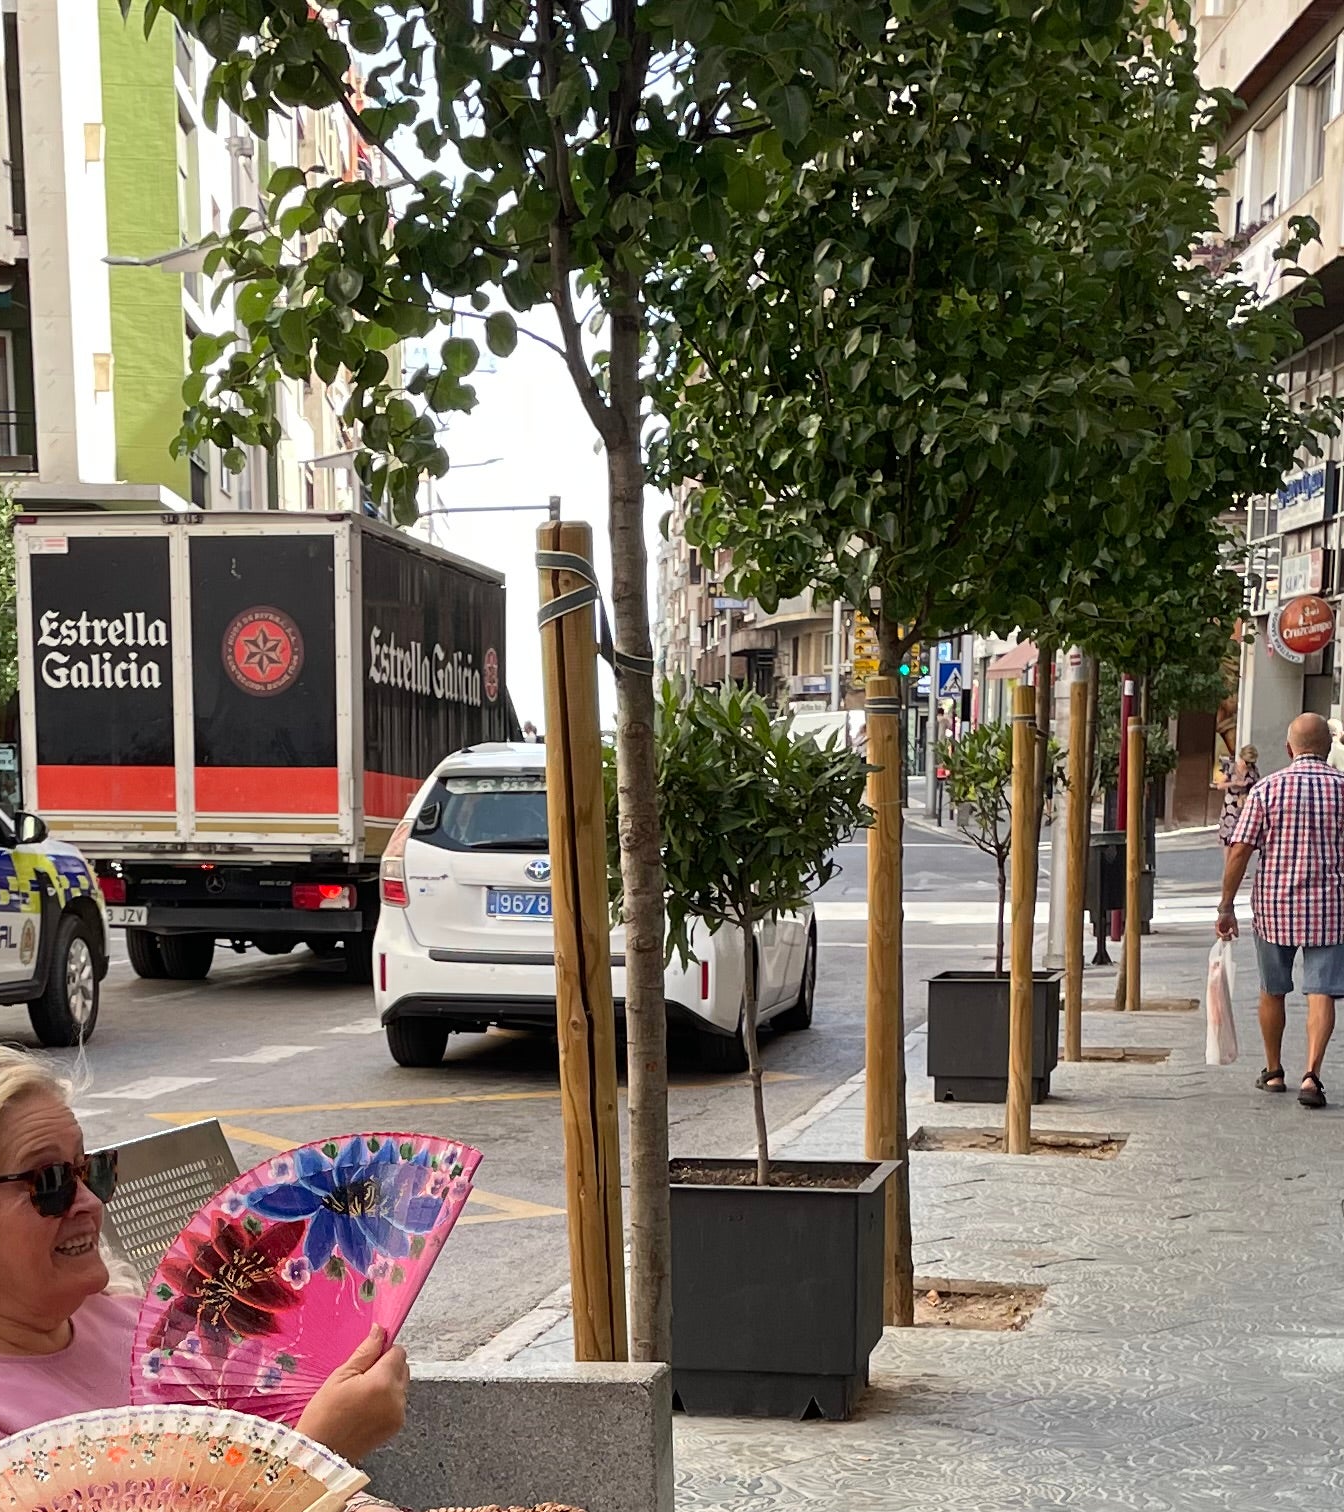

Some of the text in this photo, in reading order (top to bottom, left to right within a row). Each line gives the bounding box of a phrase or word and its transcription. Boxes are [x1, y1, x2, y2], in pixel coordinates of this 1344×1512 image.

[37, 610, 169, 647] Estrella
[42, 651, 162, 689] Galicia
[369, 625, 481, 707] Estrella Galicia
[119, 909, 144, 923] JZV
[500, 894, 549, 914] 9678
